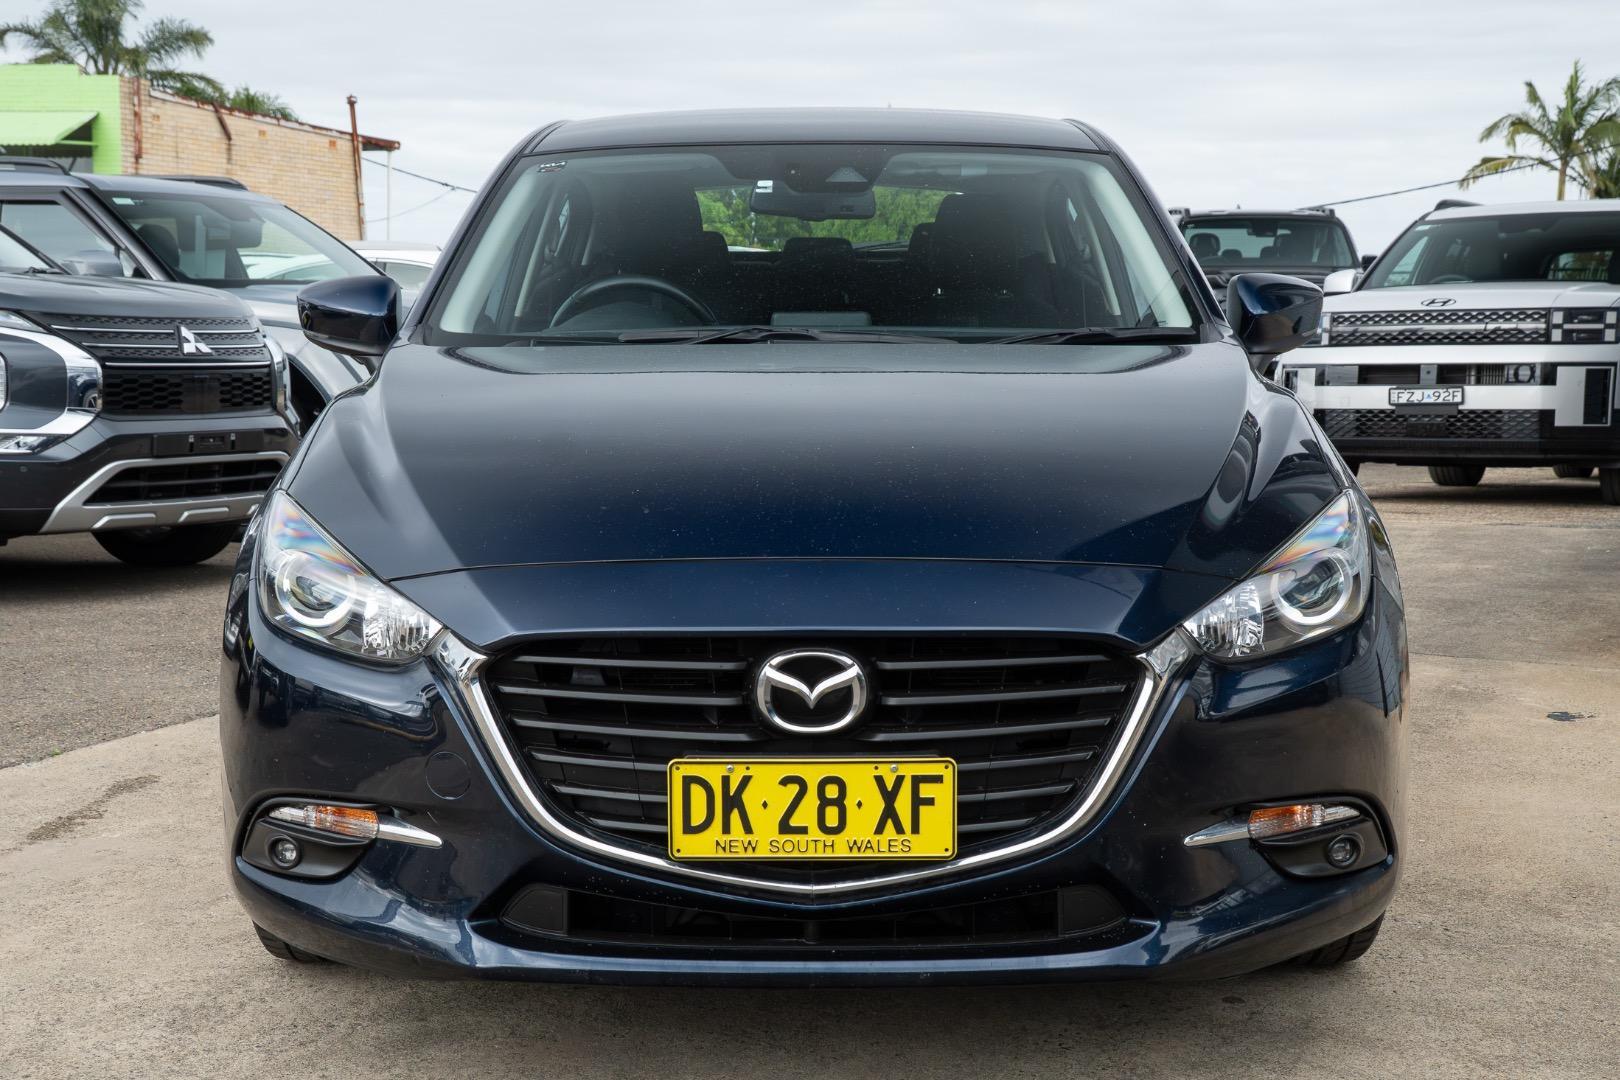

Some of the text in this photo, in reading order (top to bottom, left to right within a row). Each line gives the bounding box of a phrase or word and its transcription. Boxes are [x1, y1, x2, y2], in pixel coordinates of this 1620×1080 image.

[715, 838, 912, 854] NEW SOUTH WALES
